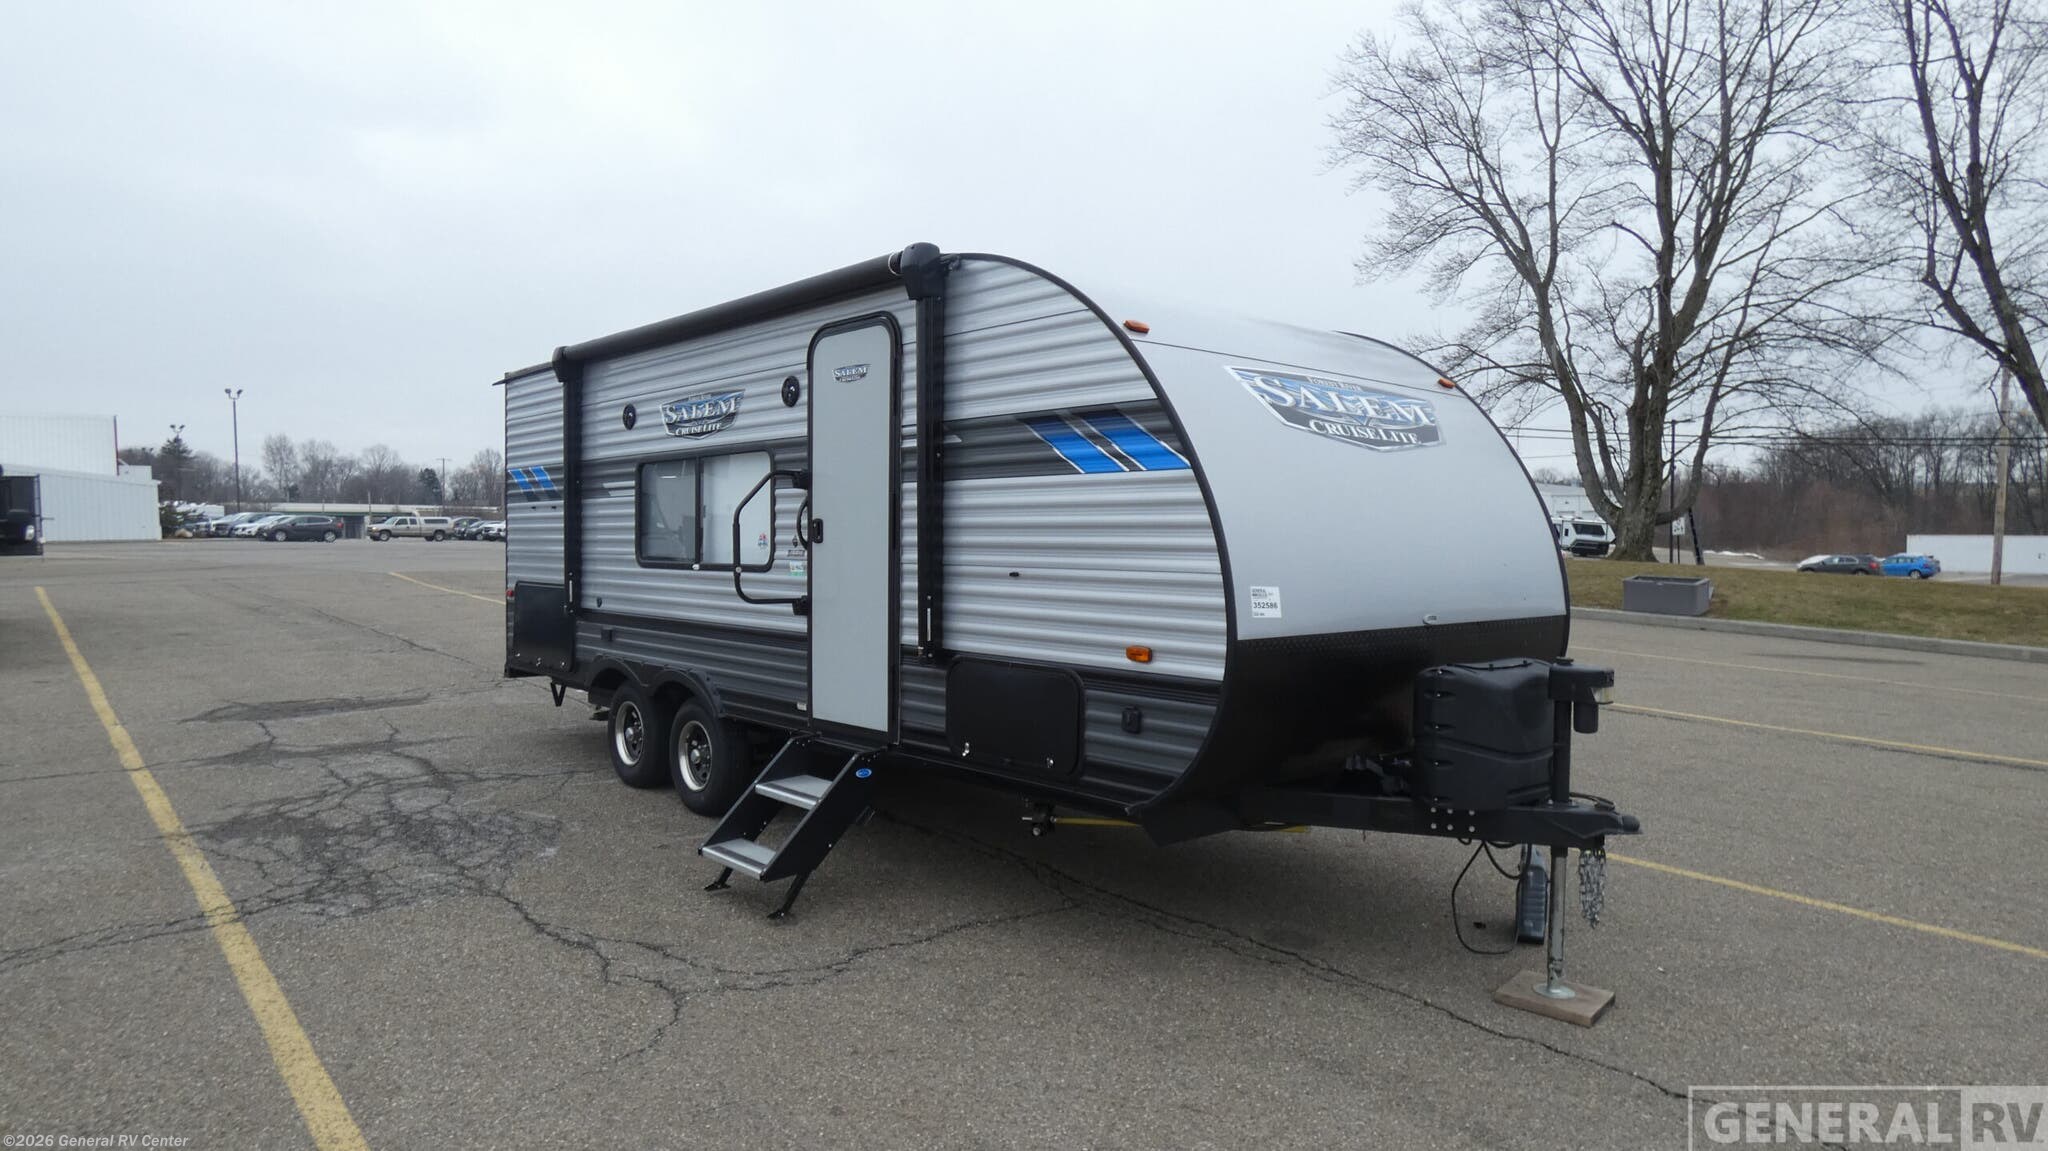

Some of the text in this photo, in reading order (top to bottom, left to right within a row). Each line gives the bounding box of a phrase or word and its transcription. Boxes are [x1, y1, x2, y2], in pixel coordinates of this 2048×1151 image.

[834, 366, 868, 377] SALEM
[664, 397, 738, 423] SALEM
[1253, 375, 1435, 426] SALEM
